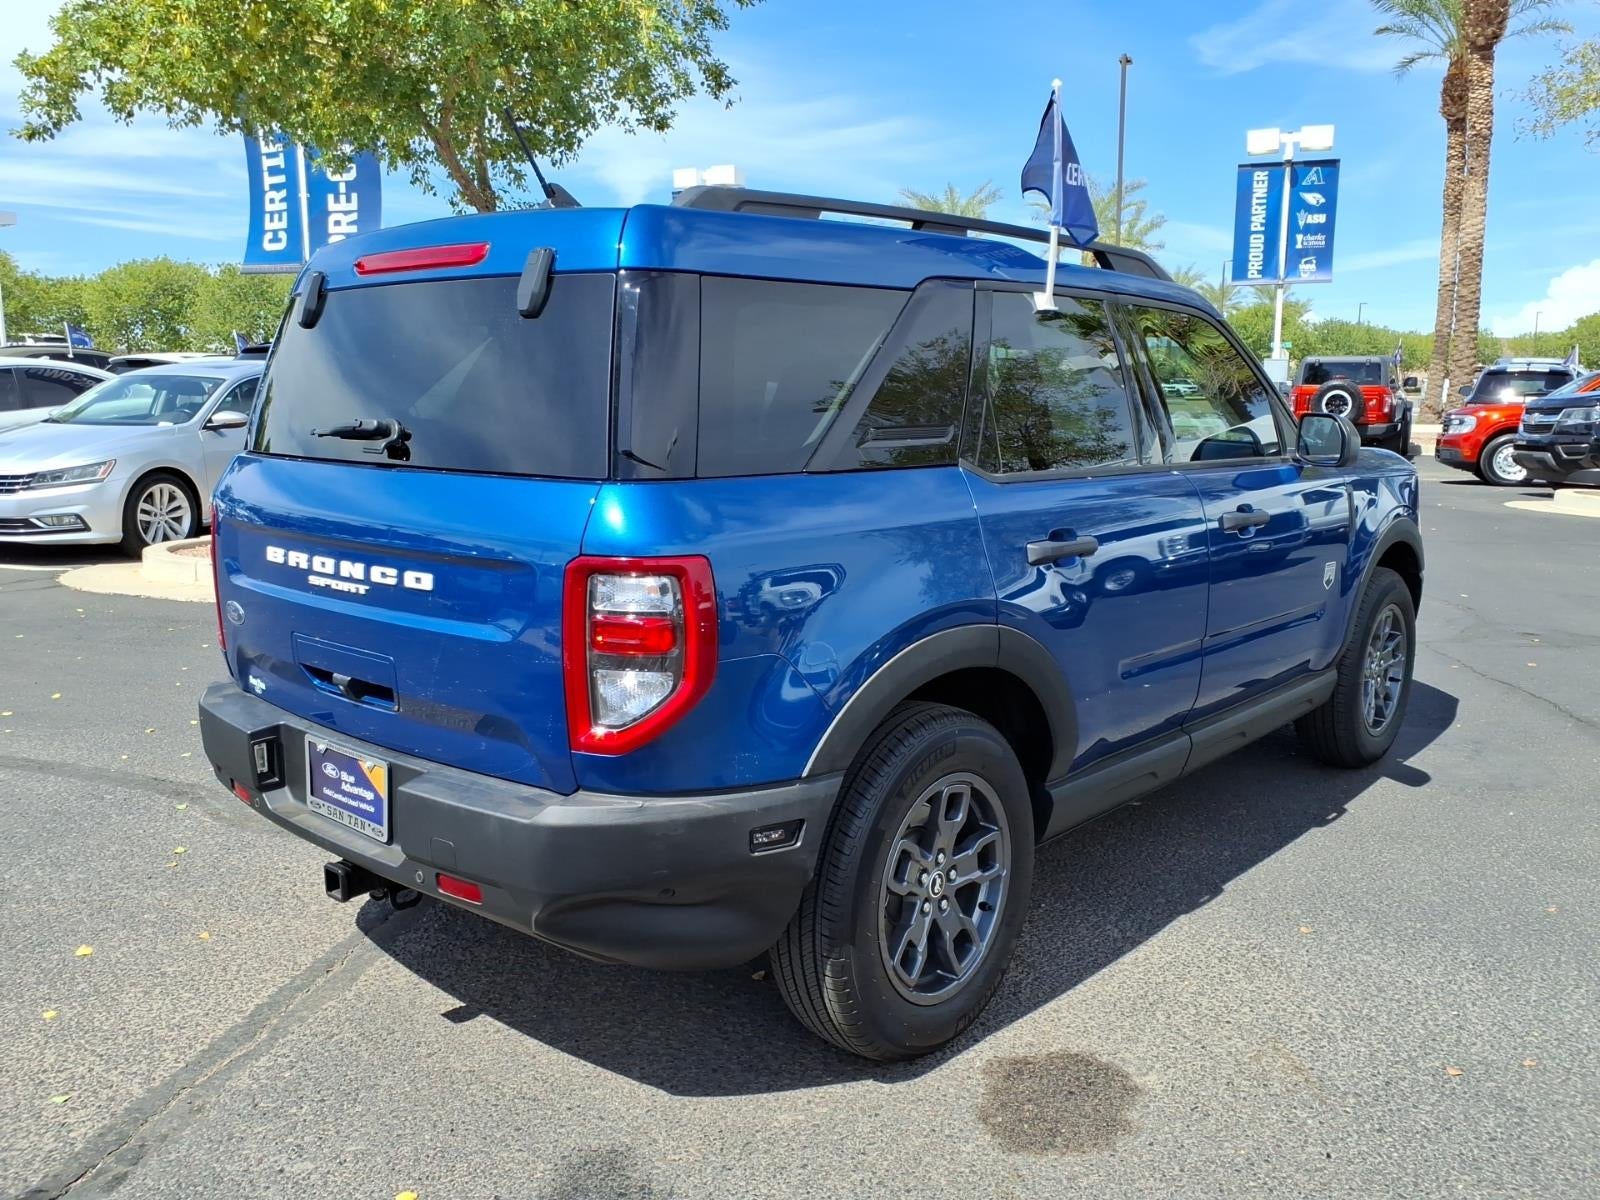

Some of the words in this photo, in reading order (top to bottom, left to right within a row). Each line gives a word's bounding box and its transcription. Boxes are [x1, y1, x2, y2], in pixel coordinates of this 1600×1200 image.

[1250, 171, 1269, 231] PARTNER
[1306, 213, 1327, 224] ASU
[1248, 233, 1265, 279] PROUD
[266, 545, 434, 591] BRONCO
[308, 575, 370, 595] SPORT
[341, 771, 355, 784] Blue
[341, 782, 374, 800] Advantage
[327, 806, 344, 821] SAN
[347, 814, 366, 831] TAN
